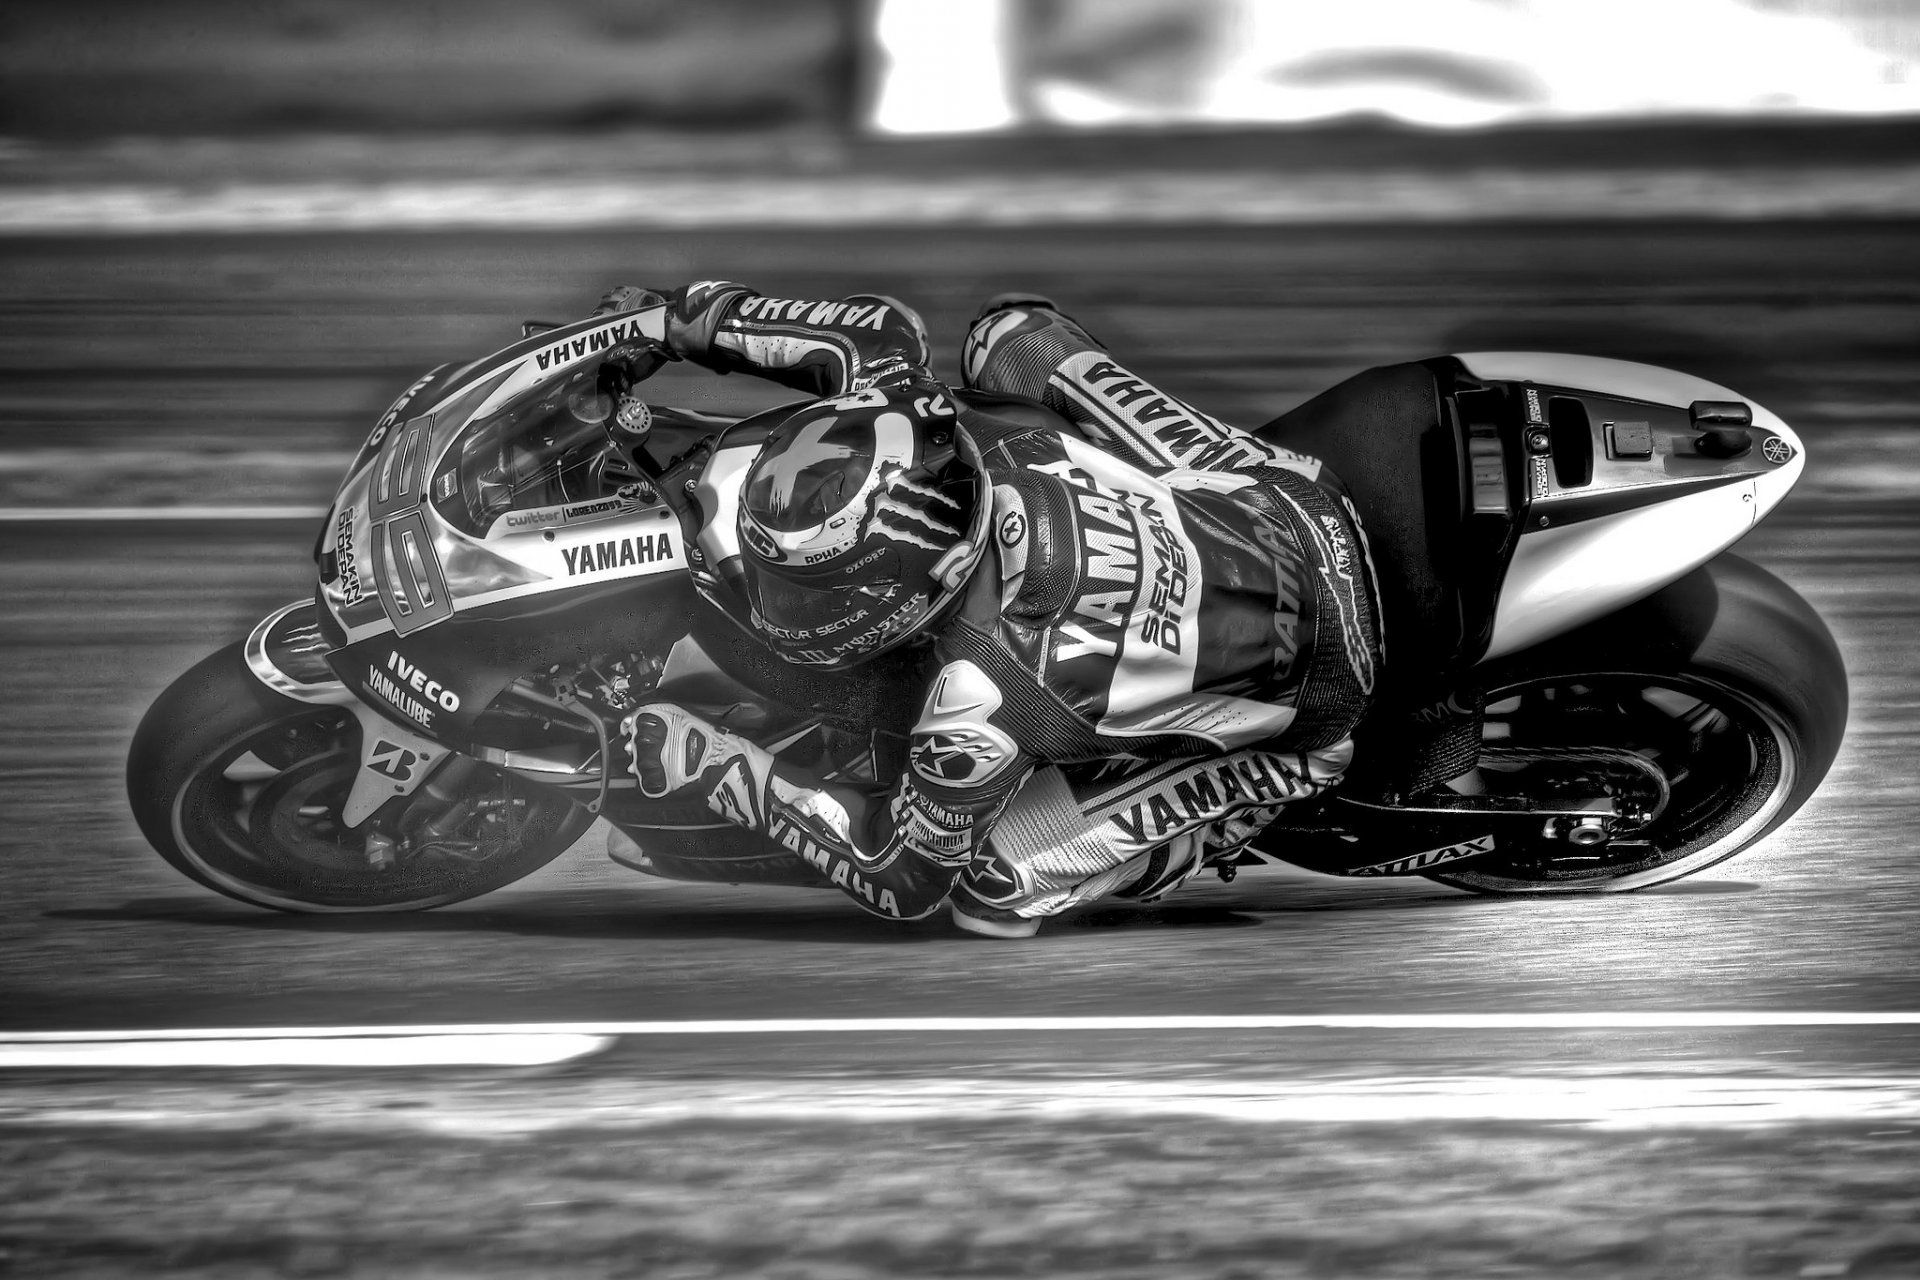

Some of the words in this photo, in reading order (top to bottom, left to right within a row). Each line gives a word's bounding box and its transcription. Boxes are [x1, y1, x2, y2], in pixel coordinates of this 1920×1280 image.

[738, 295, 891, 331] YAMAHA
[535, 319, 644, 372] YAMAHA
[1082, 361, 1251, 472] YAMAHA
[506, 510, 560, 527] twitter
[336, 531, 354, 605] DEPAN
[344, 505, 363, 606] SEMAKIN
[561, 532, 674, 577] YAMAHA
[805, 545, 842, 565] RPHA
[845, 547, 886, 574] OXFORD
[832, 592, 928, 654] MONSTER
[368, 665, 436, 729] YAMALUBE
[386, 650, 461, 714] IVECO
[926, 801, 974, 826] YAMAHA
[1110, 751, 1313, 844] YAMAHA
[768, 813, 901, 918] YAMAHA
